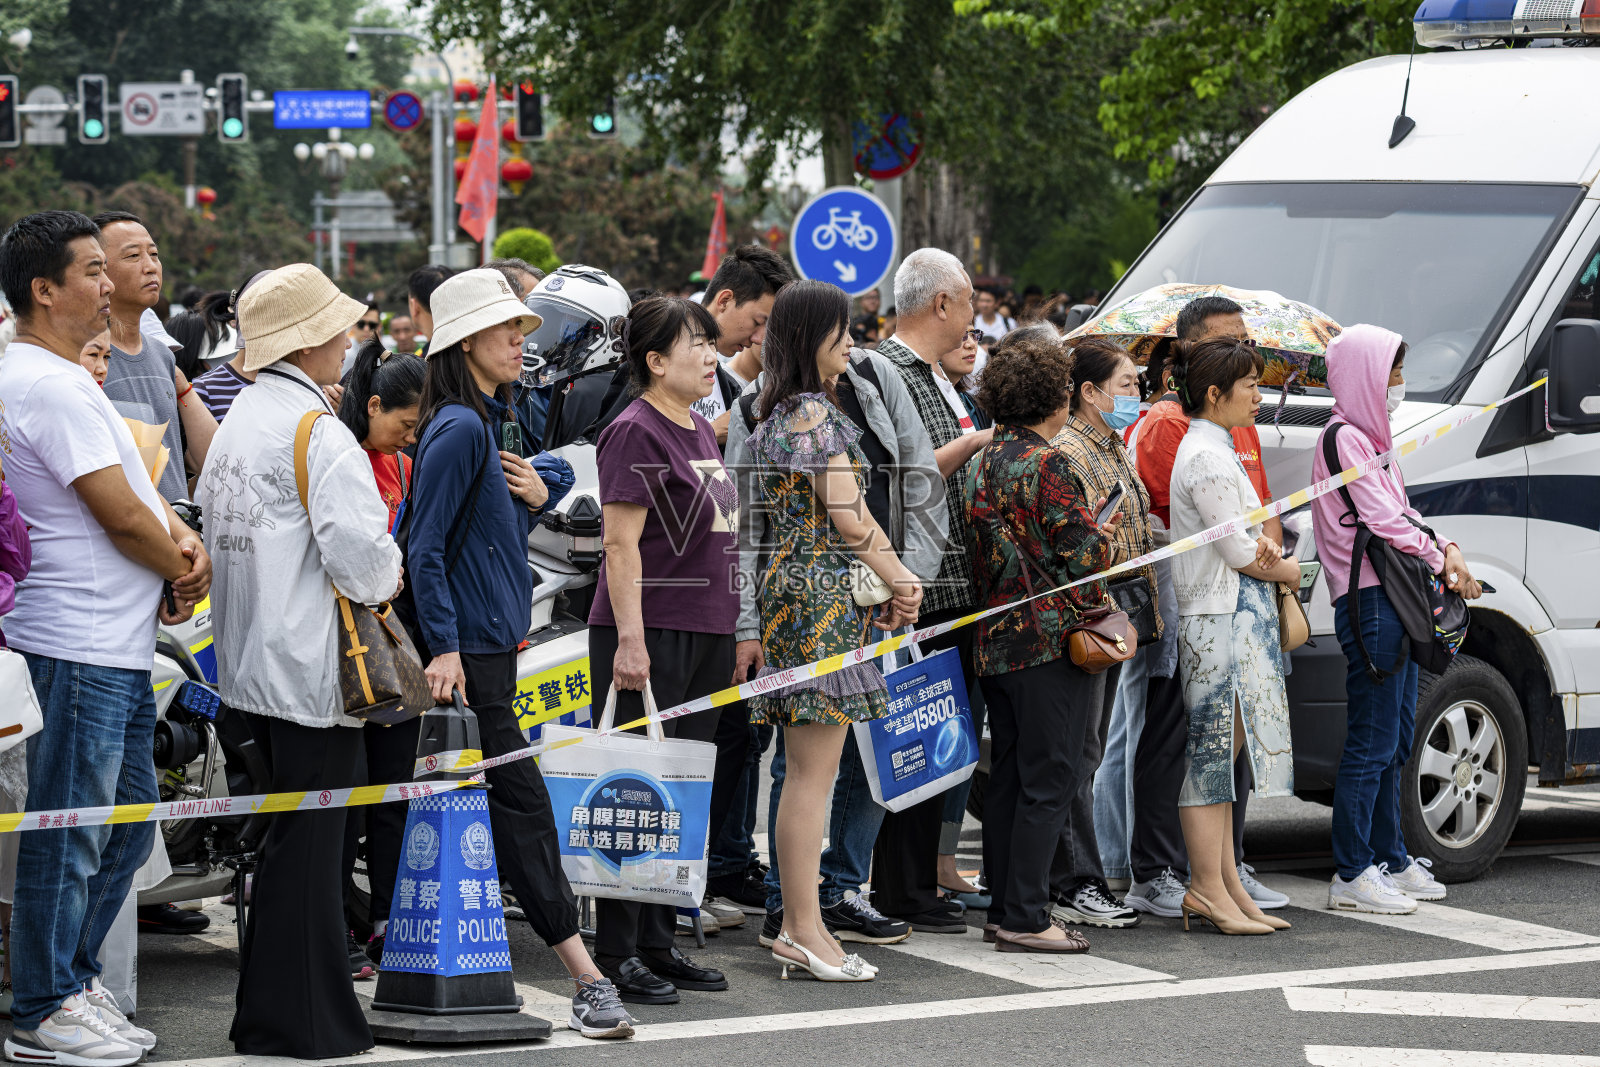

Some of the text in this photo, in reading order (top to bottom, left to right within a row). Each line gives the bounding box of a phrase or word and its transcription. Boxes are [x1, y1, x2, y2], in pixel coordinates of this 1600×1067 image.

[750, 669, 796, 694] LIMITLINE
[912, 694, 956, 733] 15800
[398, 784, 433, 800] 警戒线
[169, 798, 233, 816] LIMITLINE
[570, 805, 682, 831] 角膜塑形镜
[37, 812, 79, 829] 警戒线
[568, 828, 681, 854] 就选易视顿
[400, 877, 441, 911] 警察
[458, 877, 502, 911] 警察
[392, 917, 442, 945] POLICE
[457, 916, 508, 945] POLICE
